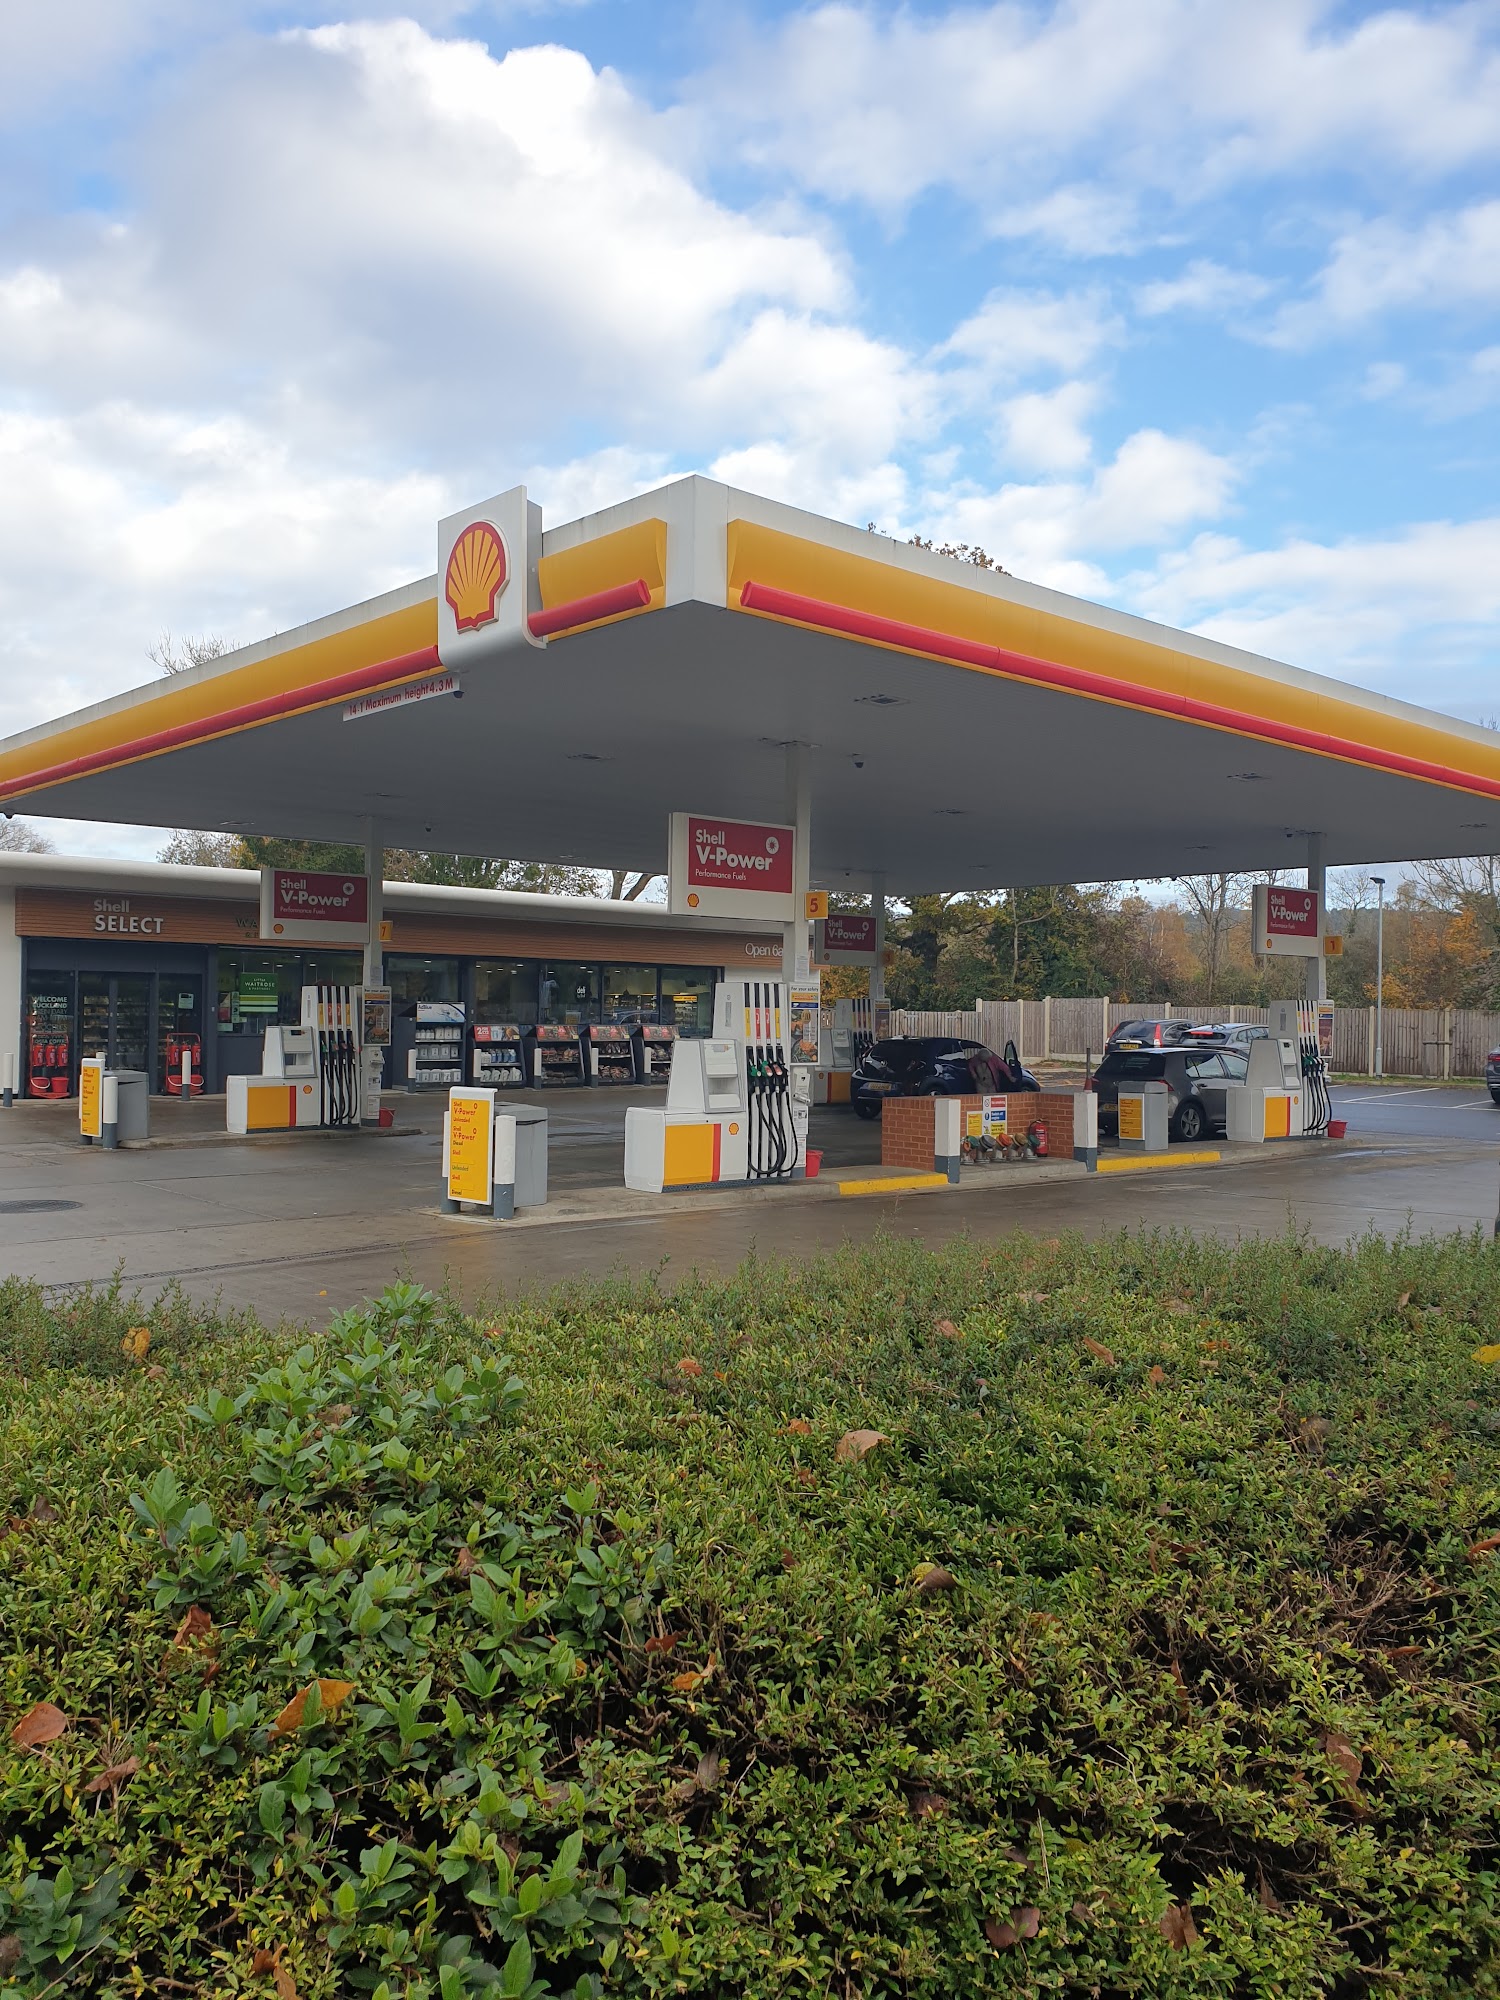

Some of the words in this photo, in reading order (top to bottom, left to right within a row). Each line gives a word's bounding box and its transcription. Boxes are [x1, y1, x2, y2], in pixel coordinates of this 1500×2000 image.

[365, 693, 401, 711] Maximum
[404, 684, 428, 700] height
[695, 828, 725, 845] Shell
[696, 844, 773, 871] V-Power
[695, 868, 731, 880] Performance
[732, 871, 747, 881] Fuels
[280, 878, 307, 890] Shell
[280, 889, 350, 907] V-Power
[1270, 894, 1286, 906] Shell
[94, 899, 130, 913] Shell
[280, 906, 312, 915] Performance
[809, 897, 819, 913] 5
[1270, 905, 1309, 922] V-Power
[94, 914, 164, 934] SELECT
[828, 919, 843, 928] Shell
[381, 926, 387, 937] 7
[828, 928, 867, 941] V-Power
[745, 942, 771, 958] Open
[576, 986, 586, 994] deli
[454, 1107, 476, 1116] V-Power
[453, 1132, 476, 1141] V-Power
